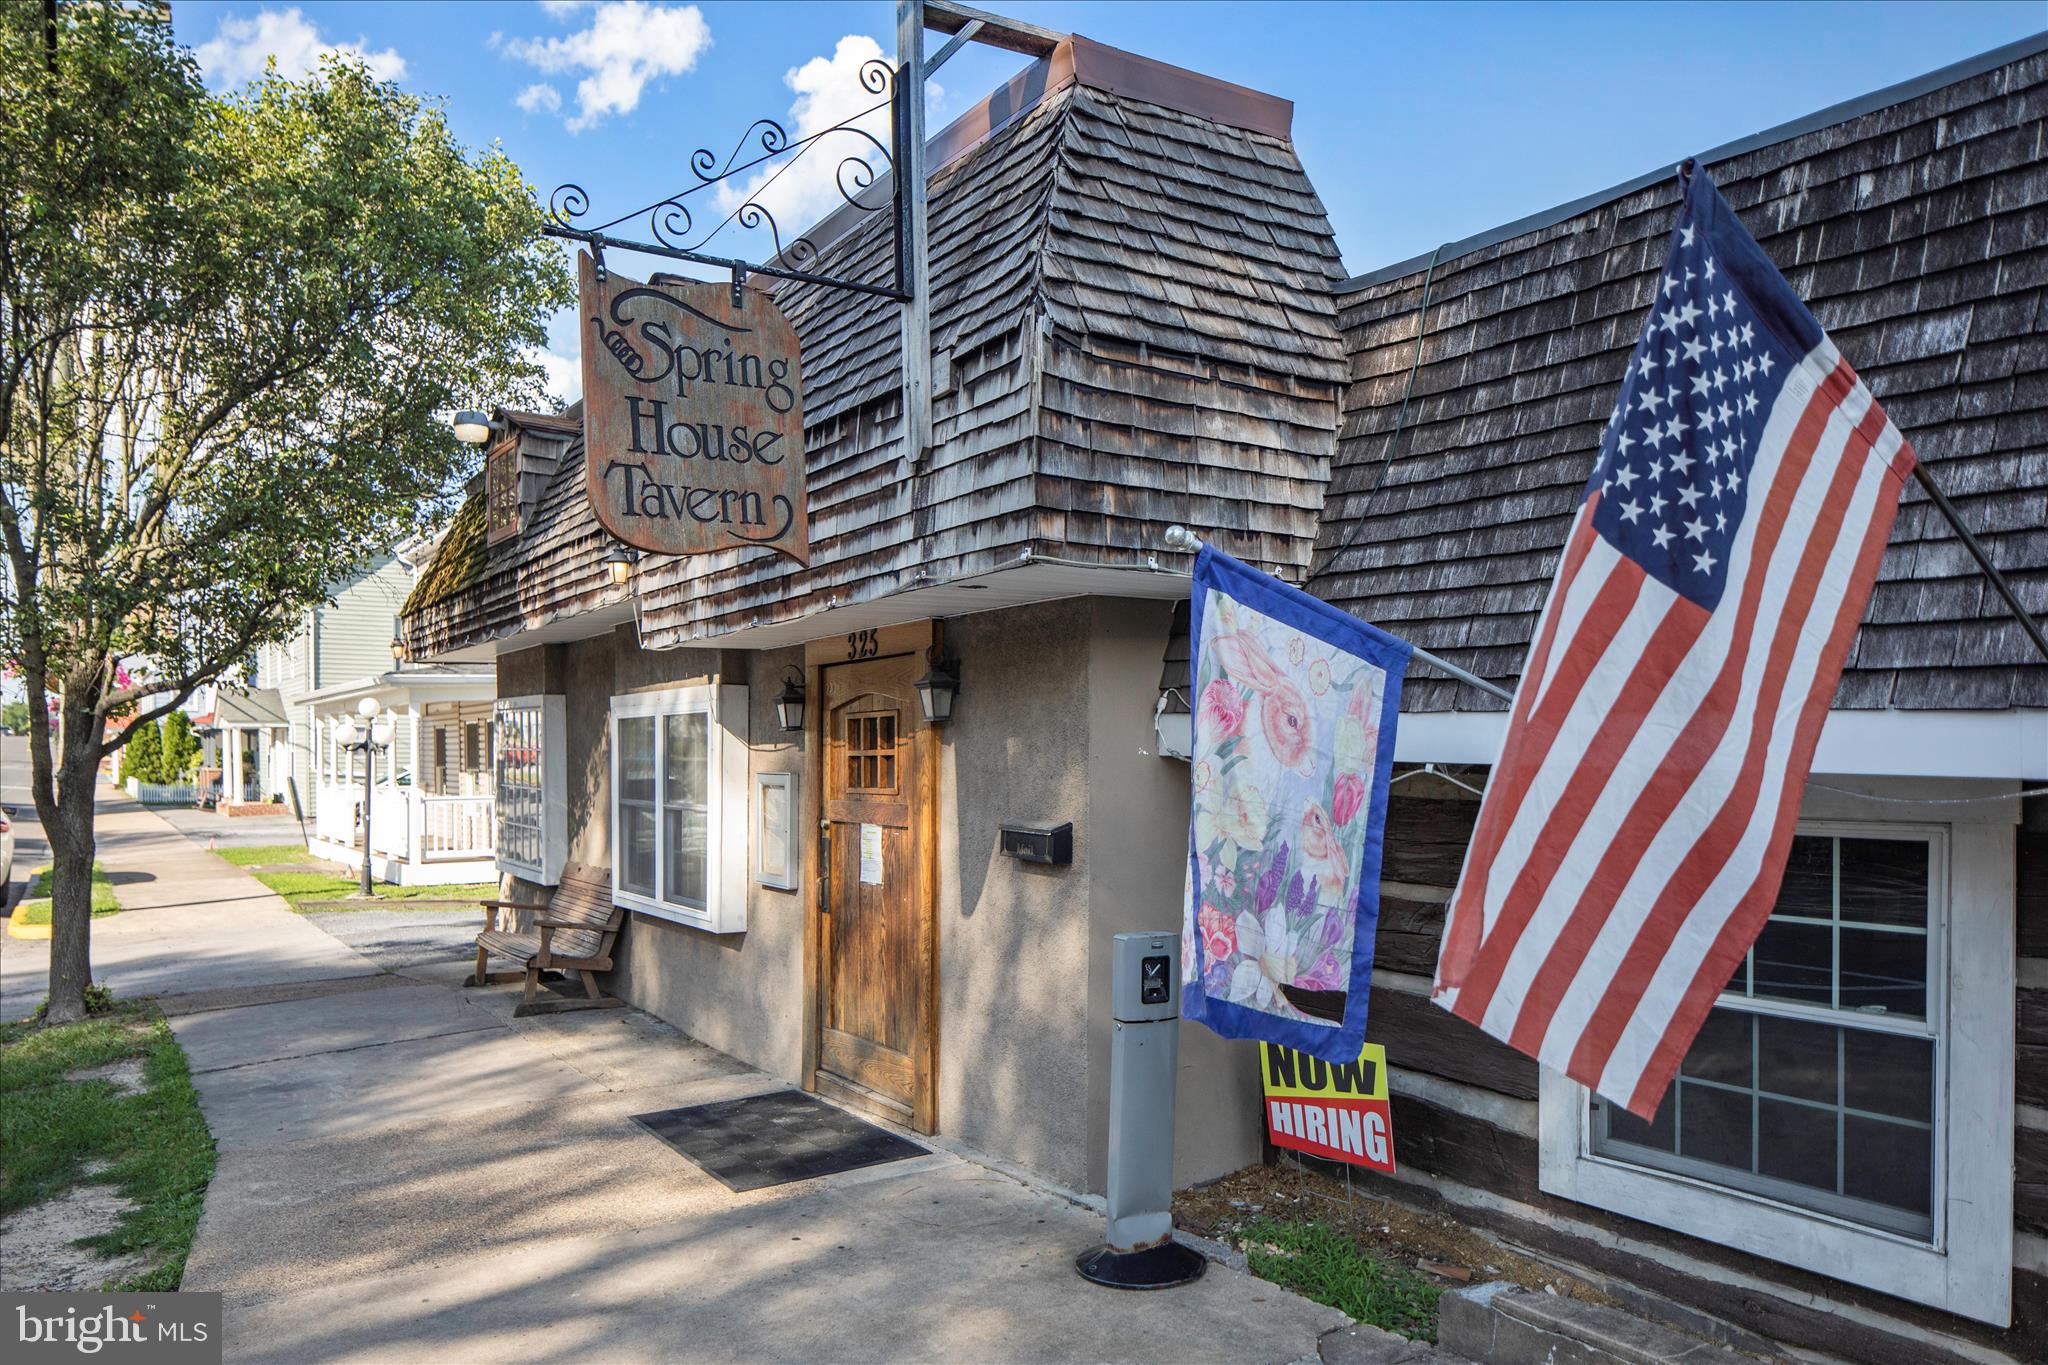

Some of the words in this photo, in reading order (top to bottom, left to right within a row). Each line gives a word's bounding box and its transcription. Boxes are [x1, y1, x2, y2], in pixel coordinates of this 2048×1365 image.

[592, 316, 795, 414] Spring
[624, 395, 785, 465] House
[604, 460, 767, 526] Tavern
[847, 627, 879, 660] 325
[1267, 1043, 1377, 1096] NOW
[1270, 1101, 1389, 1165] HIRING
